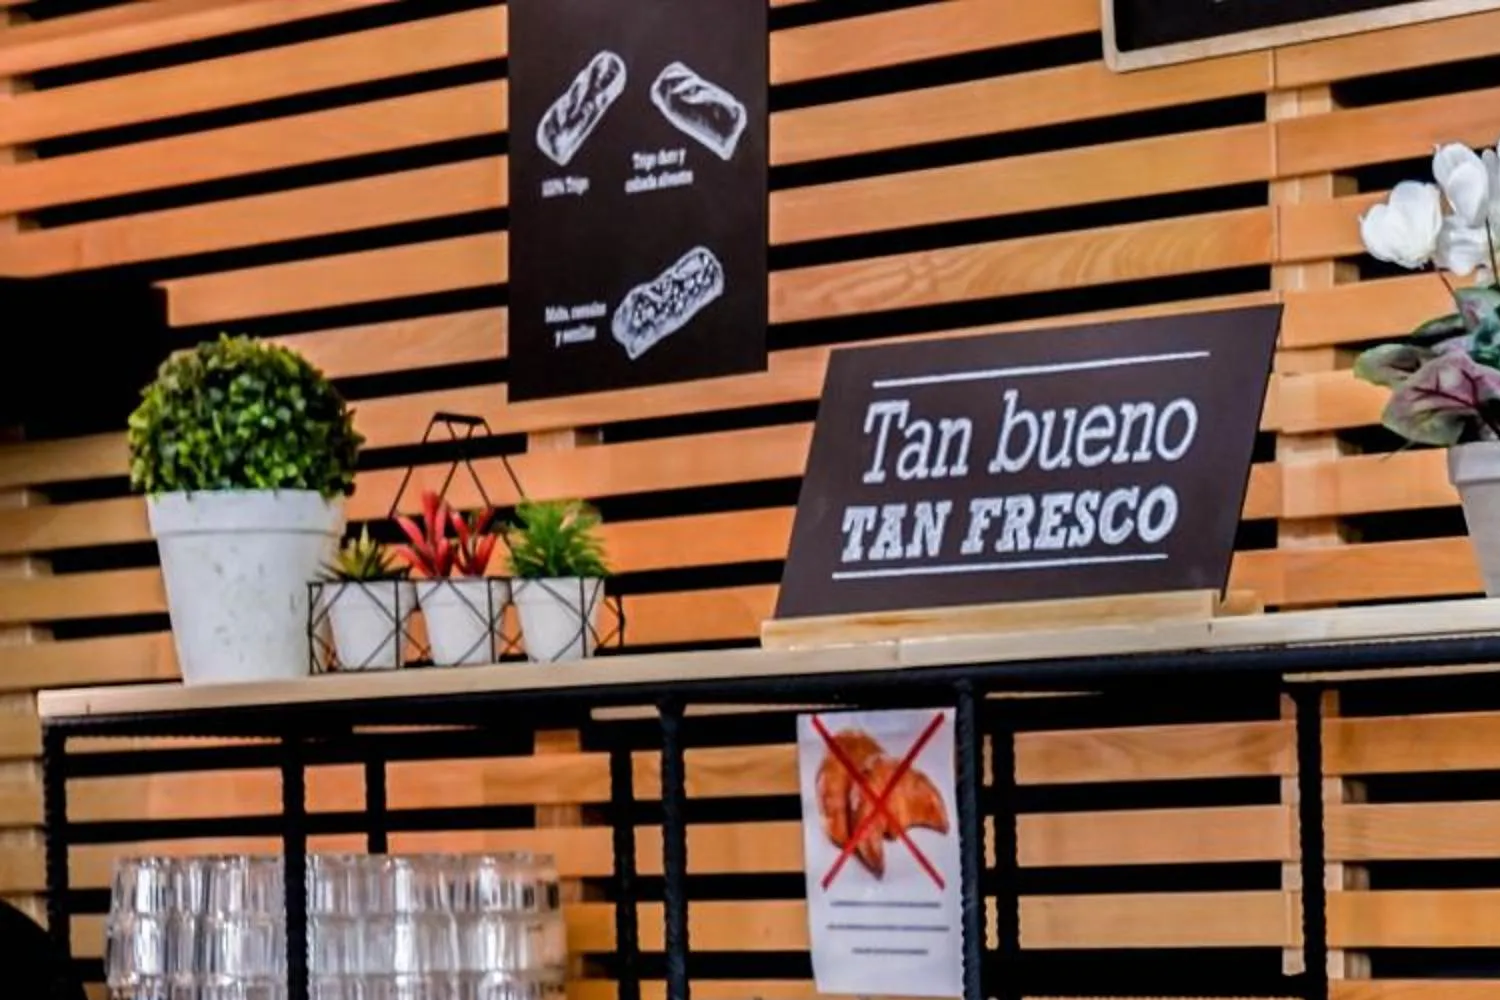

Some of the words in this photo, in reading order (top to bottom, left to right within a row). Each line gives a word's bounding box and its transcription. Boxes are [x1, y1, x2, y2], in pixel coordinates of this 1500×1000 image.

[862, 398, 972, 484] Tan
[987, 389, 1199, 475] bueno
[840, 500, 953, 563] TAN
[960, 484, 1180, 556] FRESCO
